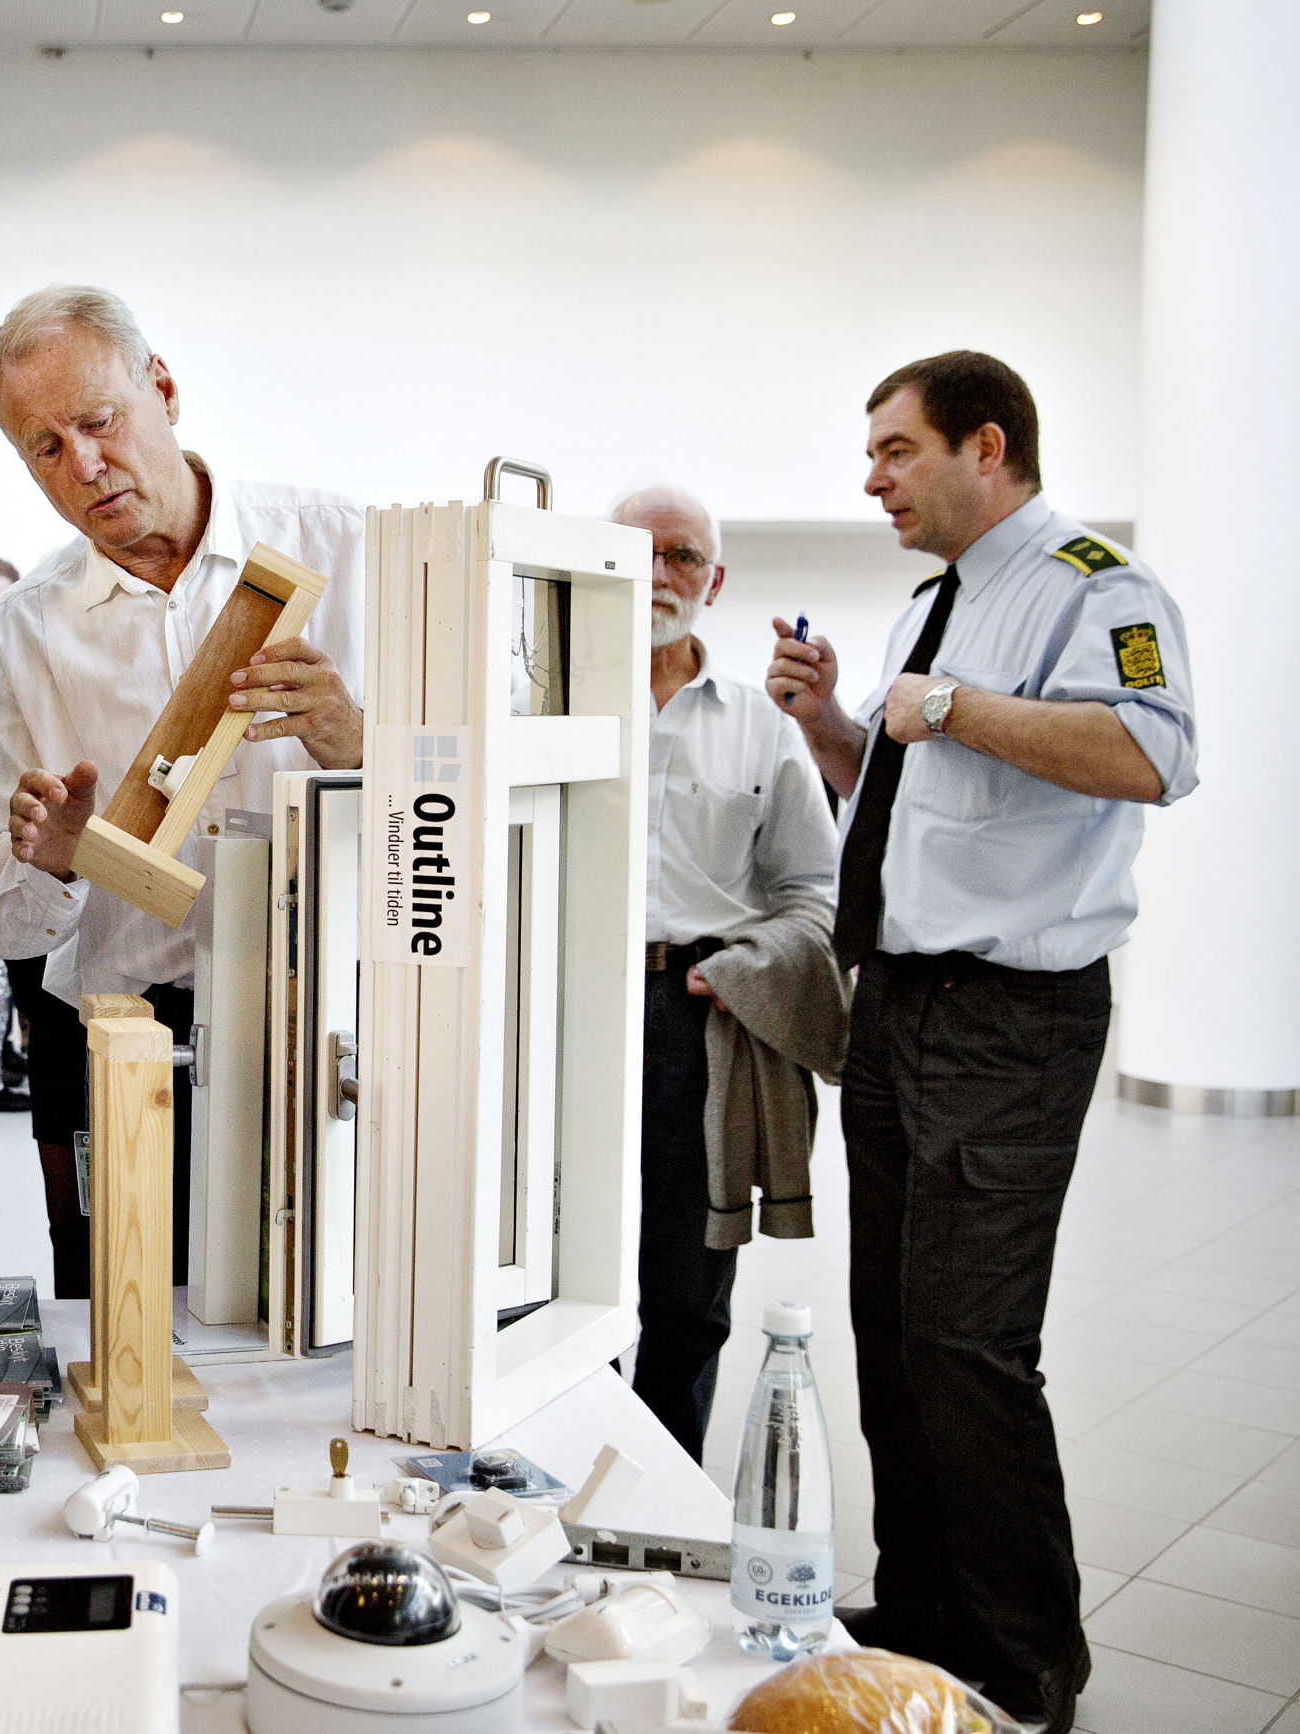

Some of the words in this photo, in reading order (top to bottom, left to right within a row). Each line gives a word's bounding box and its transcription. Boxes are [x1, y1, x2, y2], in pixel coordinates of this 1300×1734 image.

[388, 811, 404, 867] Vinduer
[388, 871, 403, 885] til
[411, 793, 456, 956] Outline
[387, 889, 403, 926] tiden
[8, 1338, 29, 1363] Beskyt
[755, 1586, 832, 1606] EGEKILDE
